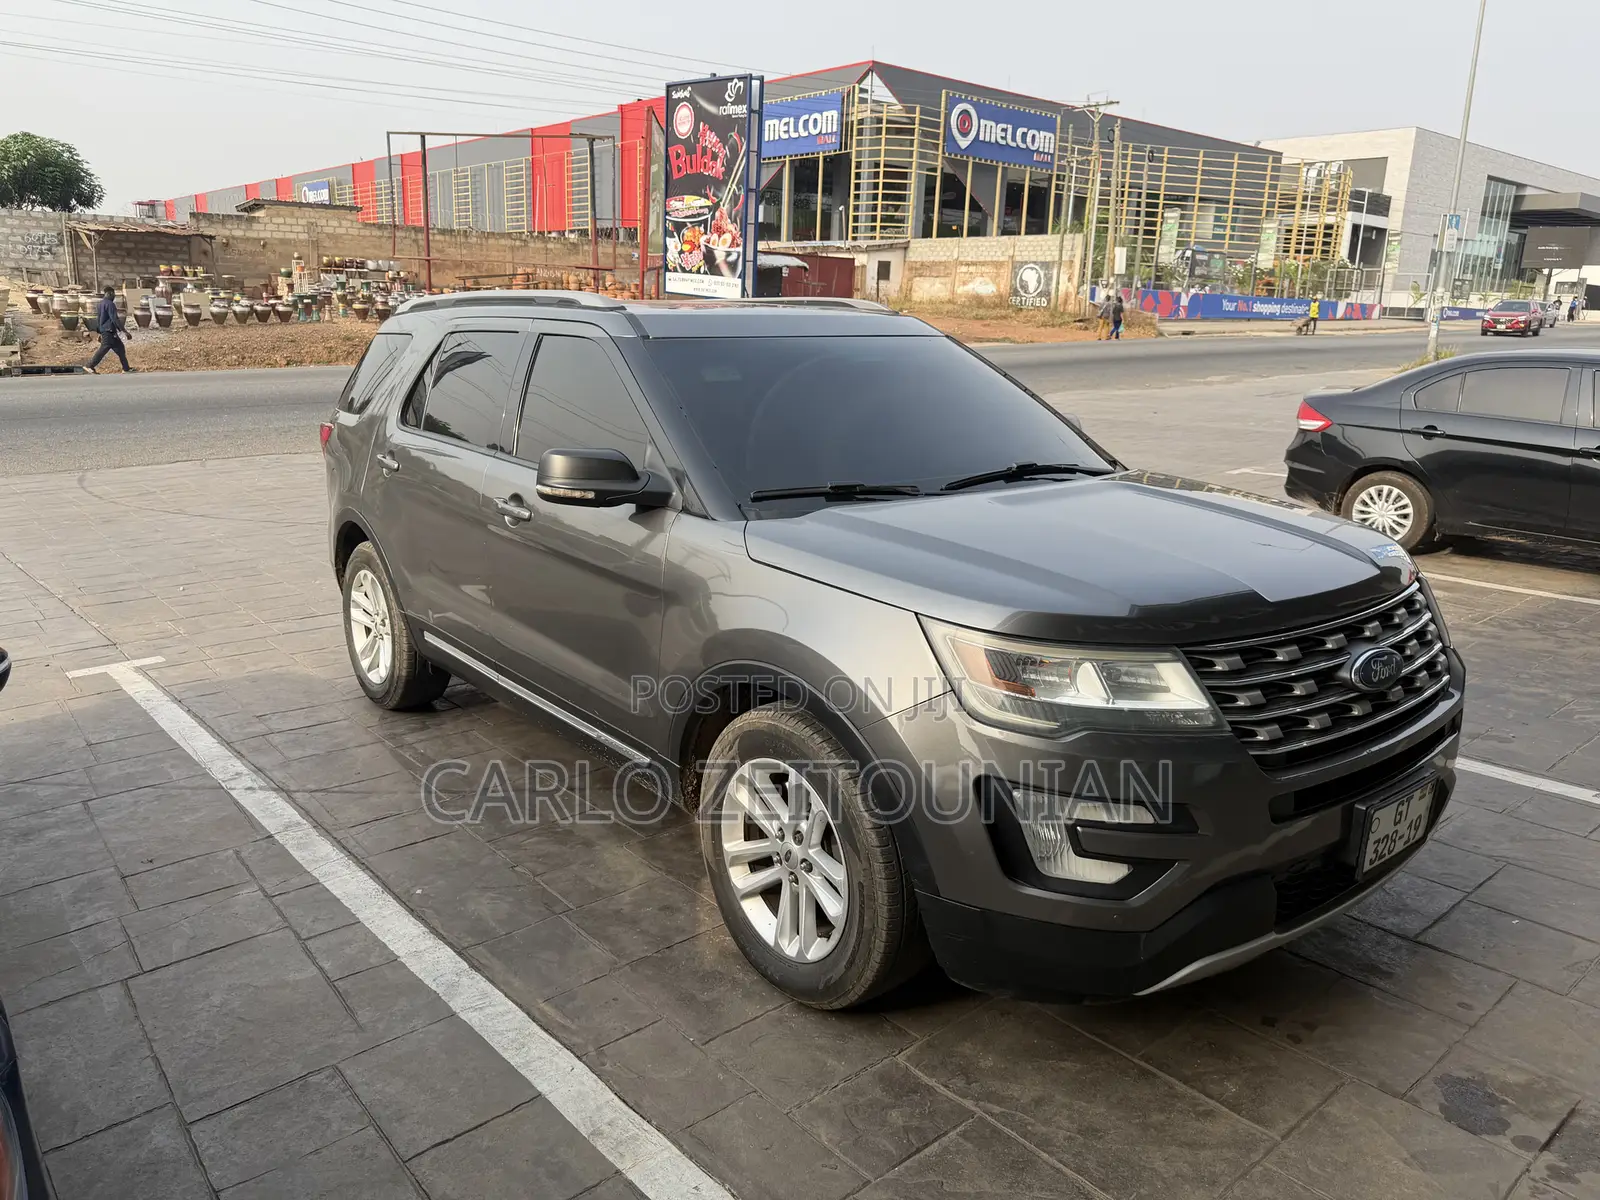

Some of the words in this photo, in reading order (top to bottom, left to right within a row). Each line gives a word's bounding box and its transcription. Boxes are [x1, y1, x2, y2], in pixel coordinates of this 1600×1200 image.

[764, 110, 839, 142] MELCOM
[979, 118, 1055, 154] MELCOM
[667, 143, 726, 181] Buldak
[1008, 296, 1048, 307] CERTIFIED
[1222, 299, 1238, 312] Your
[1252, 301, 1281, 316] shopping
[1370, 655, 1397, 683] Ford
[1393, 794, 1415, 828] GT
[1368, 814, 1423, 866] 328-19
